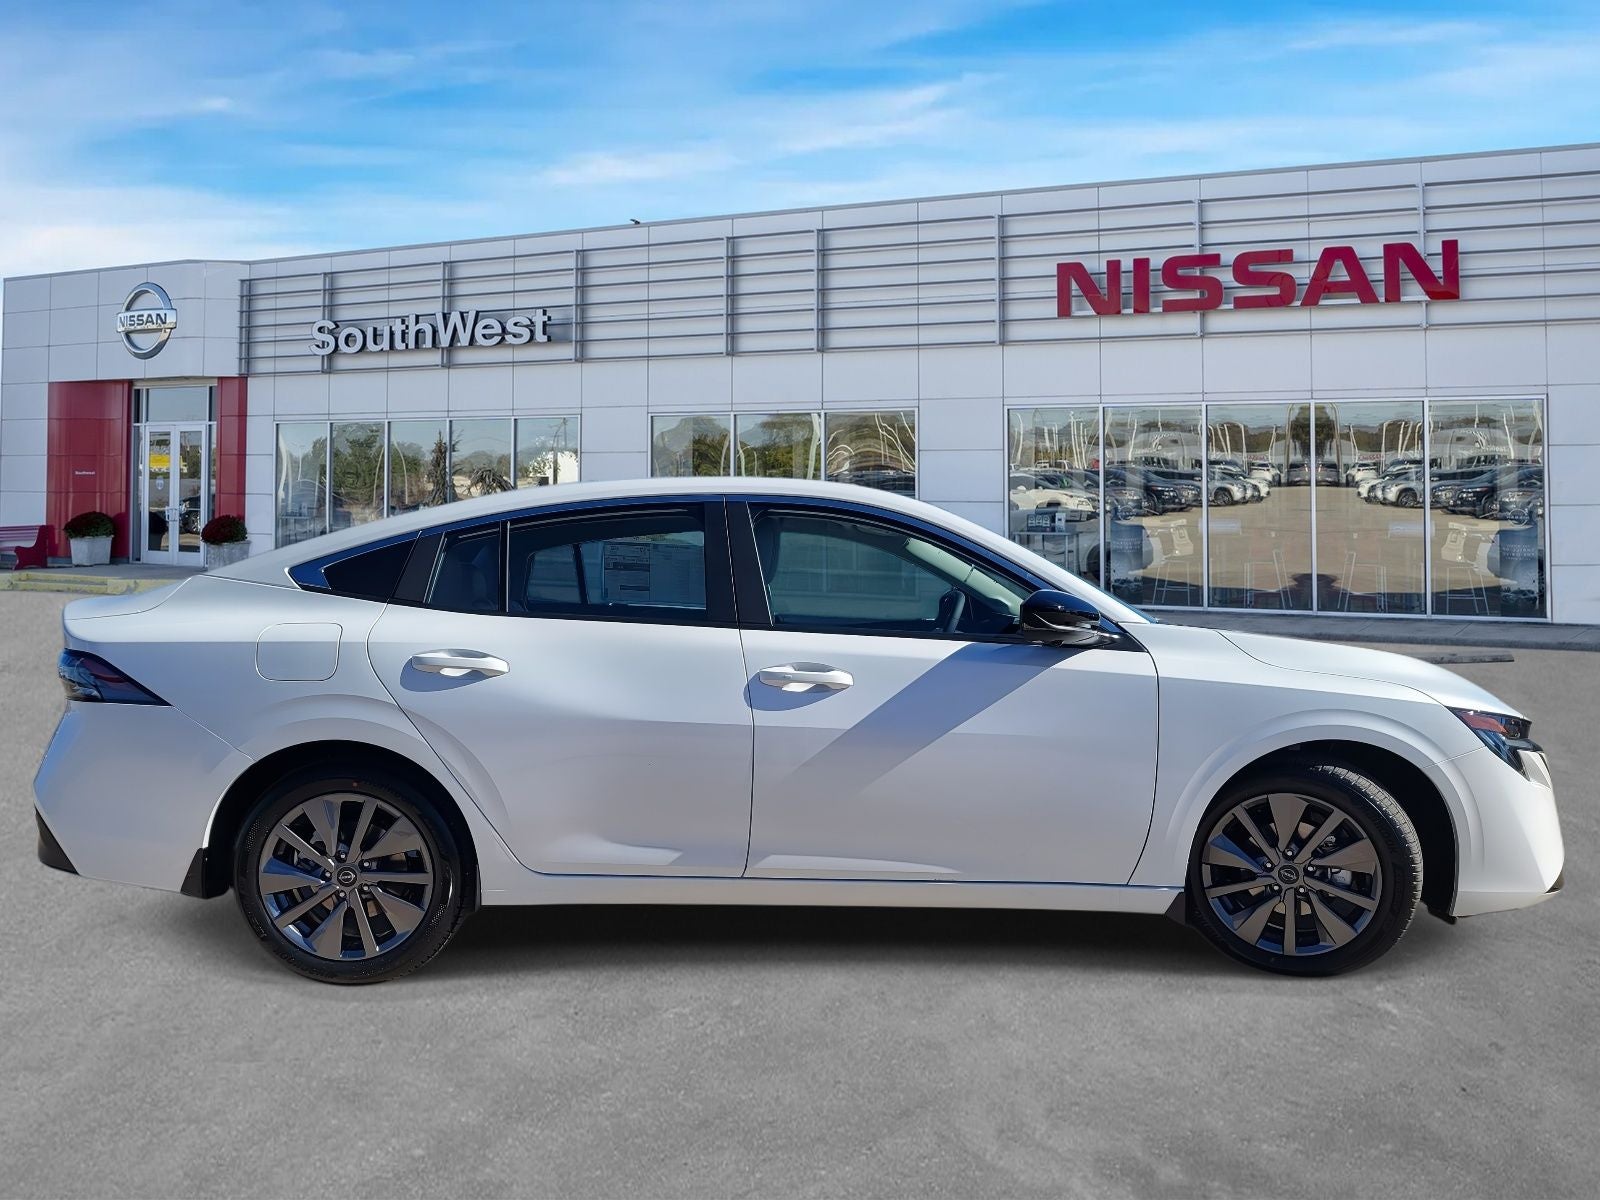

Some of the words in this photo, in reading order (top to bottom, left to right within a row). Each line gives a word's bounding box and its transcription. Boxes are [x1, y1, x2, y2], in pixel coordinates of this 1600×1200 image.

[1056, 239, 1460, 318] NISSAN
[119, 312, 168, 328] NISSAN
[309, 308, 551, 356] SouthWest
